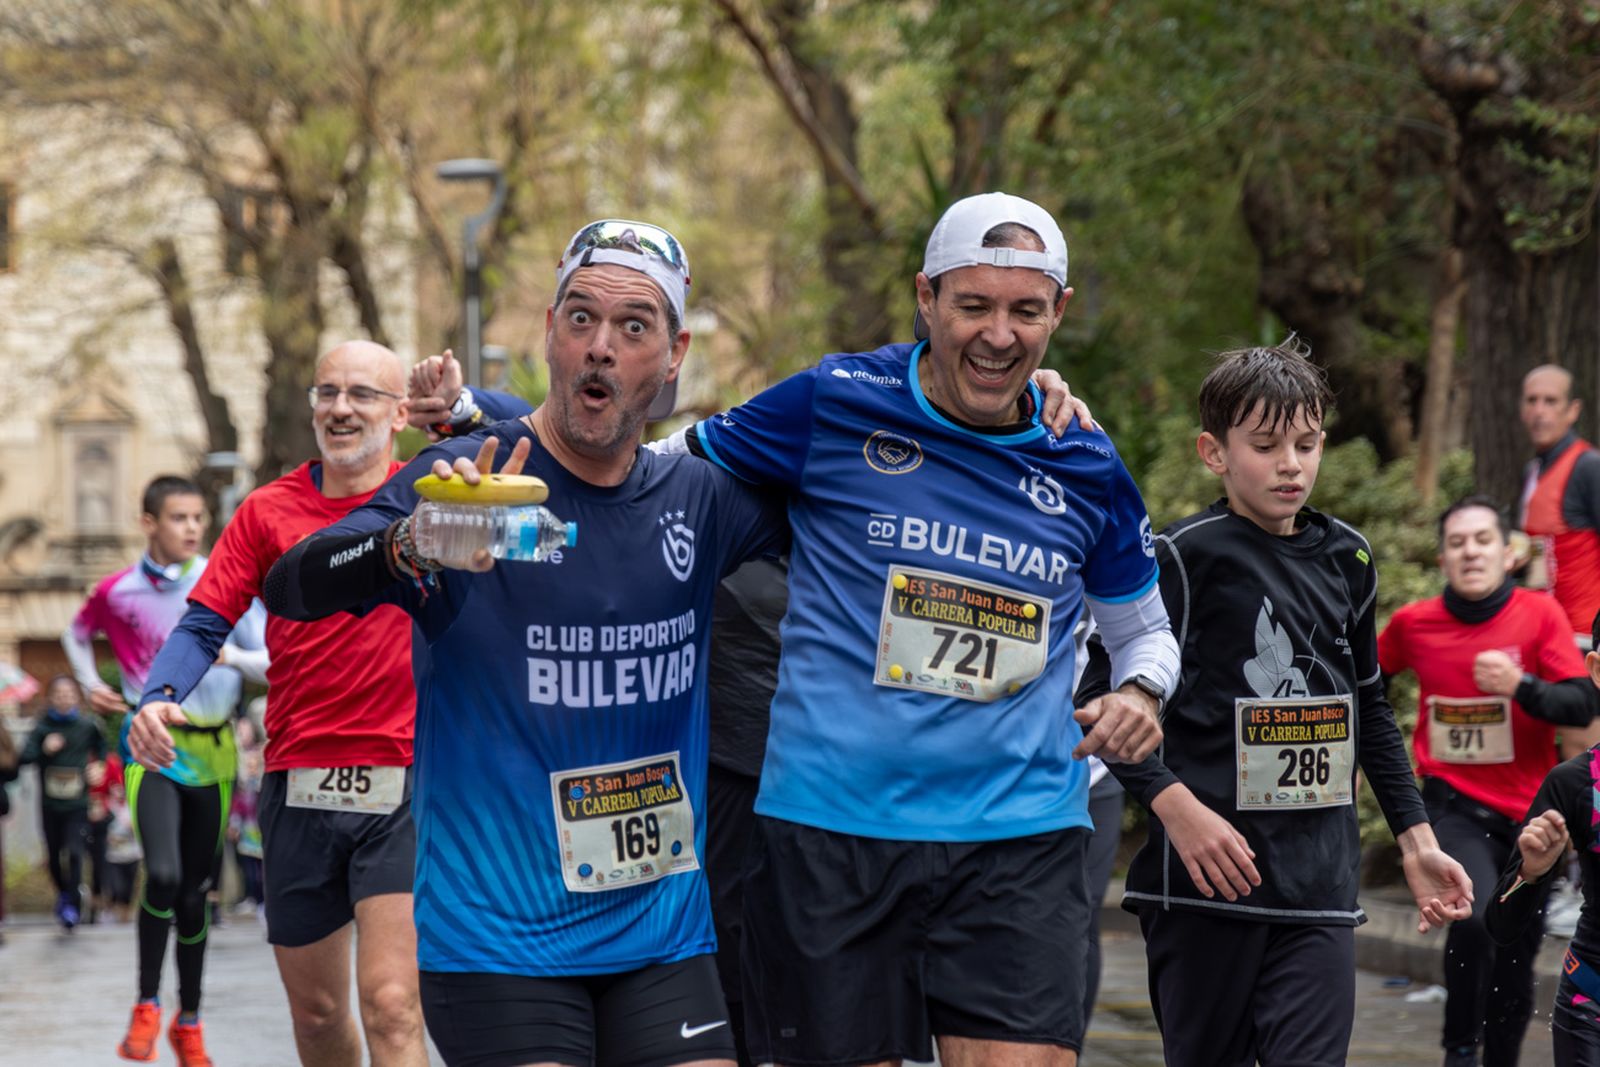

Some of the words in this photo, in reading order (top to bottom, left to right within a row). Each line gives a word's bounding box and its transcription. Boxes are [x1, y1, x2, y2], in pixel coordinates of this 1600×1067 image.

[852, 370, 903, 386] neumax
[867, 520, 896, 539] CD
[901, 516, 1069, 585] BULEVAR
[898, 596, 909, 613] V
[911, 599, 974, 626] CARRERA
[978, 612, 1036, 640] POPULAR
[930, 582, 956, 601] San
[960, 587, 992, 610] Juan
[995, 599, 1026, 618] Bosc
[527, 624, 594, 652] CLUB
[600, 608, 695, 652] DEPORTIVO
[928, 626, 998, 680] 721
[526, 642, 696, 708] BULEVAR
[1251, 705, 1271, 723] IES
[1274, 709, 1297, 723] San
[1300, 708, 1321, 723] Juan
[1322, 706, 1345, 720] Bosco
[1247, 726, 1257, 742] V
[1261, 725, 1312, 742] CARRERA
[1314, 723, 1347, 740] POPULAR
[1449, 727, 1484, 751] 971
[318, 766, 373, 794] 285
[595, 777, 622, 793] San
[625, 772, 646, 789] Juan
[1277, 746, 1330, 787] 286
[567, 800, 577, 817] V
[583, 791, 641, 816] CARRERA
[641, 784, 680, 807] POPULAR
[611, 812, 661, 863] 169
